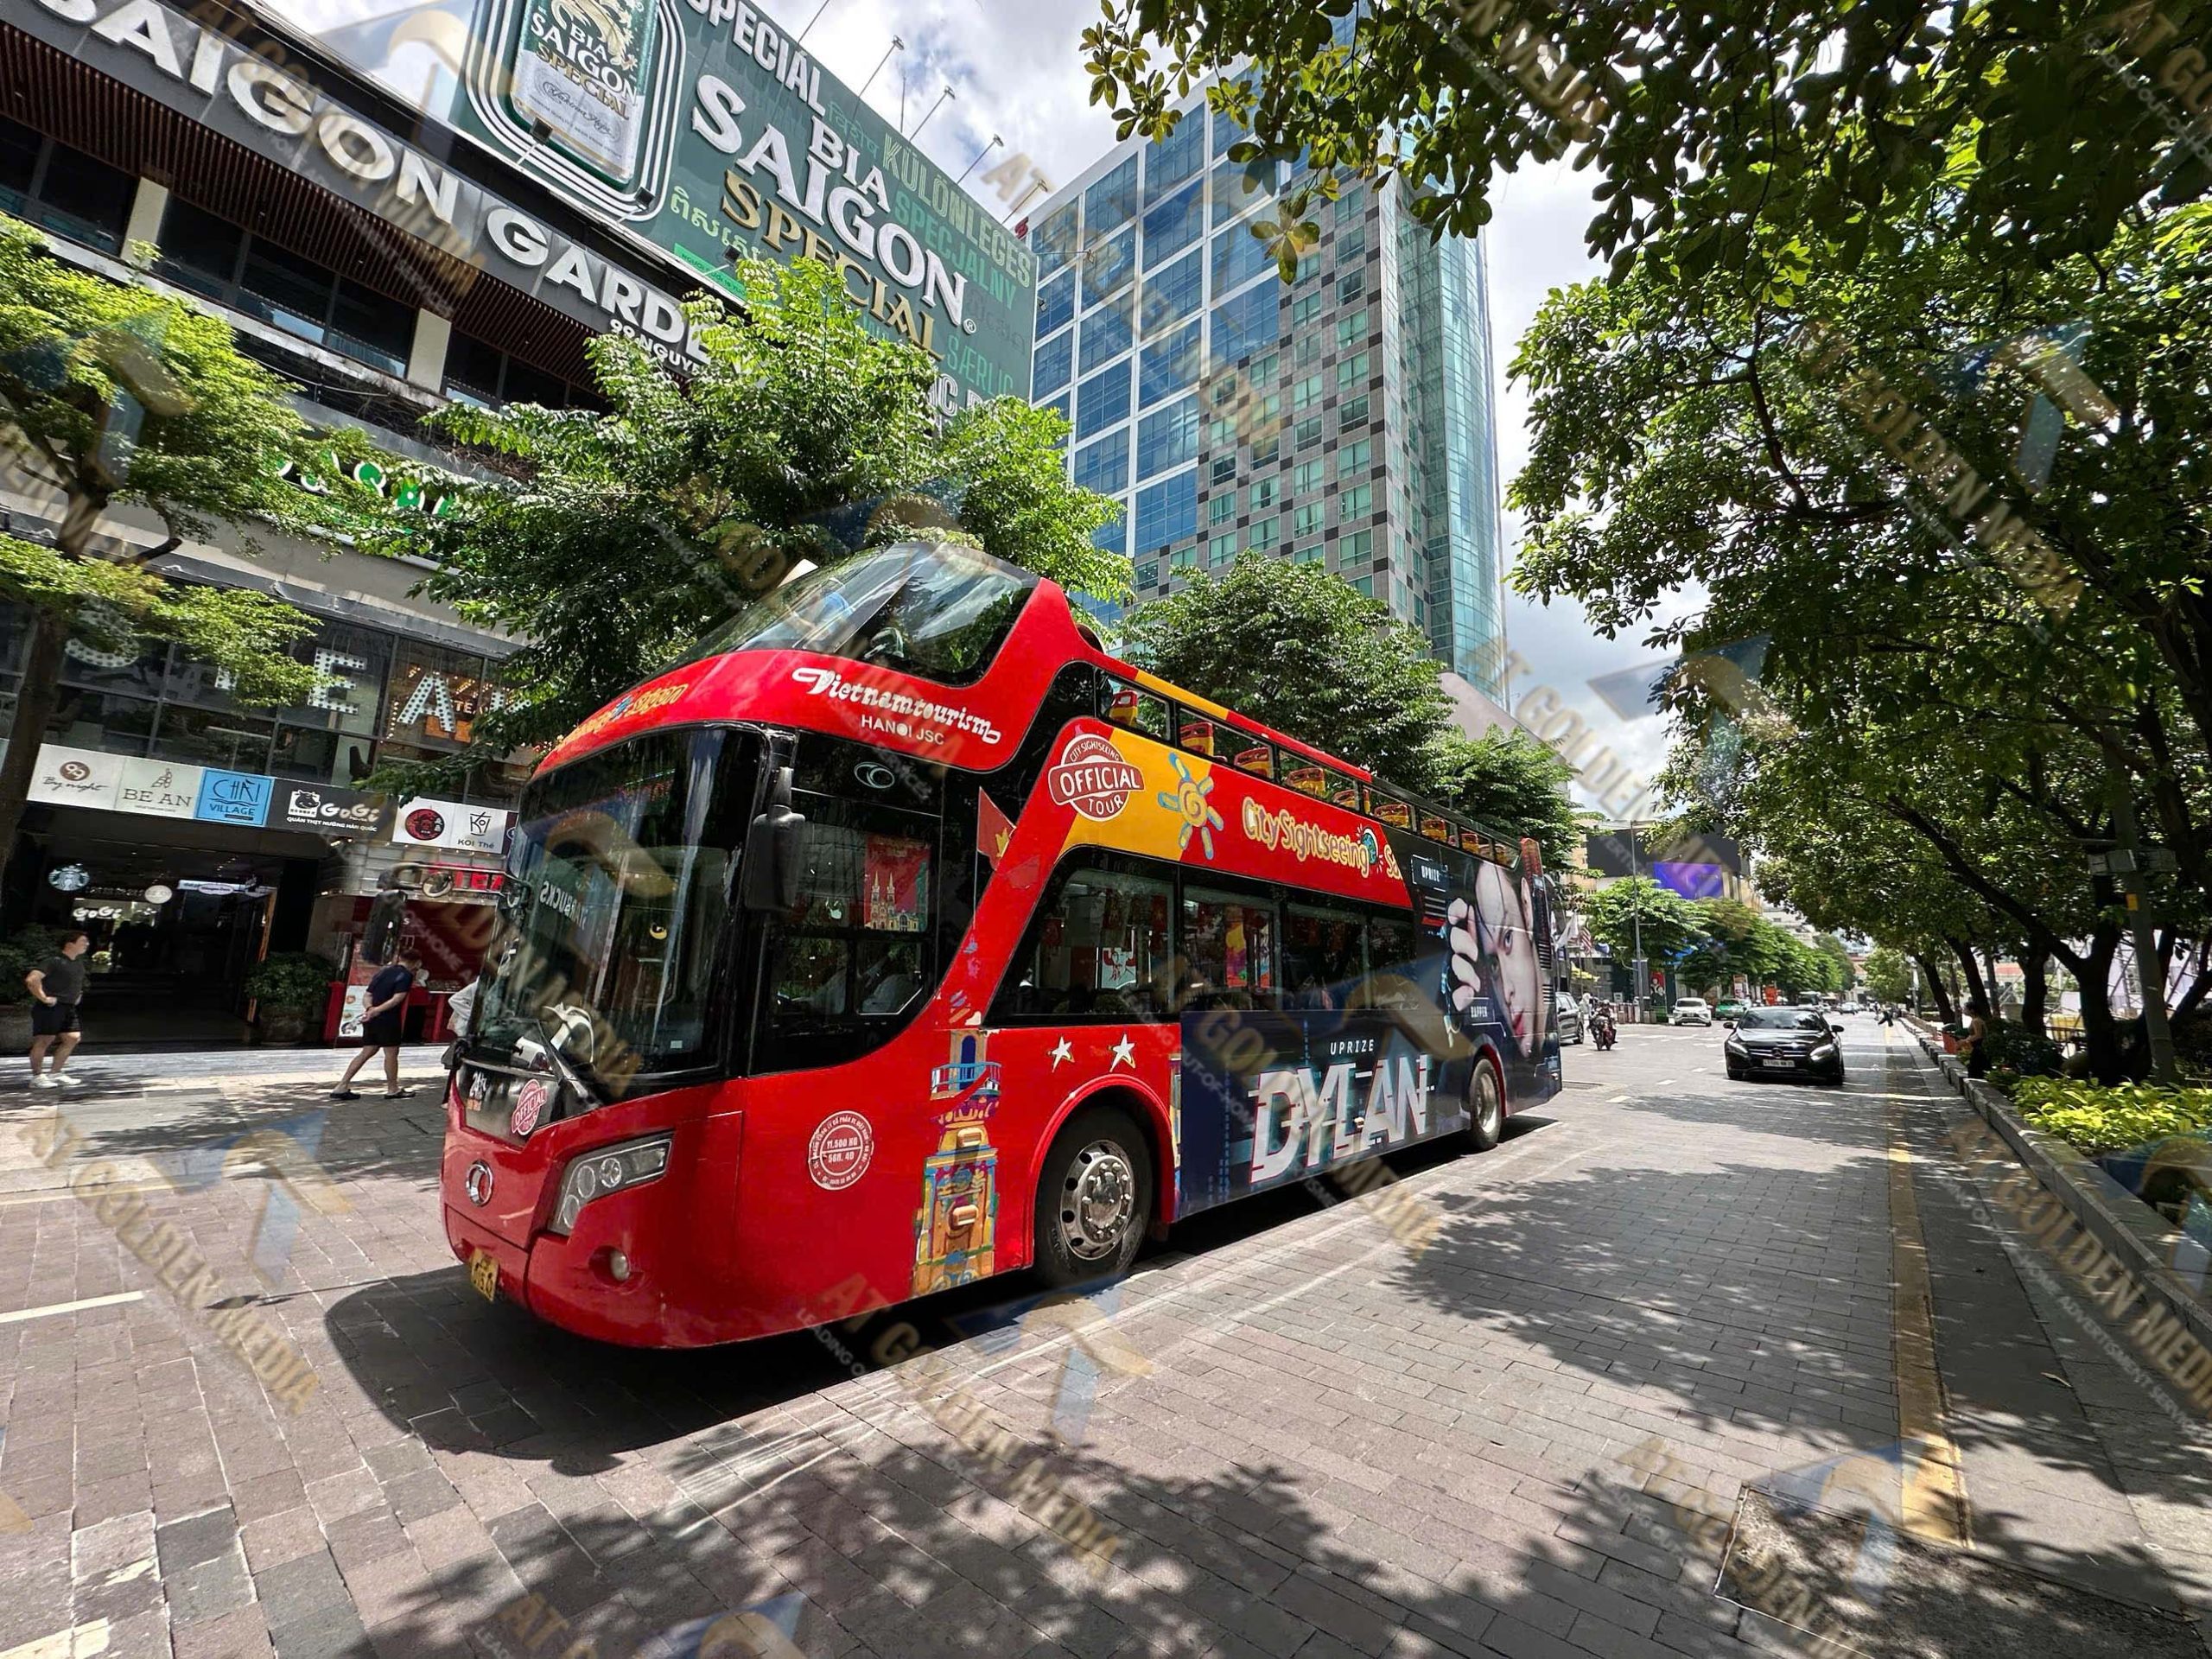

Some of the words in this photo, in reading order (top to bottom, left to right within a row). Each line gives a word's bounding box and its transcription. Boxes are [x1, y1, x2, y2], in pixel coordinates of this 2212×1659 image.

[531, 12, 638, 105] SAIGON
[570, 24, 609, 62] BIA
[536, 42, 630, 120] SPECIAL
[809, 115, 891, 213] BIA
[692, 74, 969, 327] SAIGON
[895, 191, 1017, 311] SPECJALNY
[486, 207, 769, 387] GARDE
[791, 667, 1002, 744] Vietnamtourism
[861, 715, 912, 737] HANOI
[916, 728, 944, 745] JSC
[1070, 746, 1082, 762] CITY
[1081, 741, 1119, 761] SIGHTSEEING
[1059, 766, 1141, 797] OFFICIAL
[209, 803, 256, 817] VILLAGE
[1089, 794, 1123, 815] TOUR
[457, 838, 474, 847] KOI
[479, 840, 494, 849] Thé
[1421, 865, 1441, 883] UPRIZE
[1330, 1039, 1375, 1055] UPRIZE
[515, 1090, 546, 1125] OFFICIAL
[1249, 1053, 1428, 1184] DYLAN
